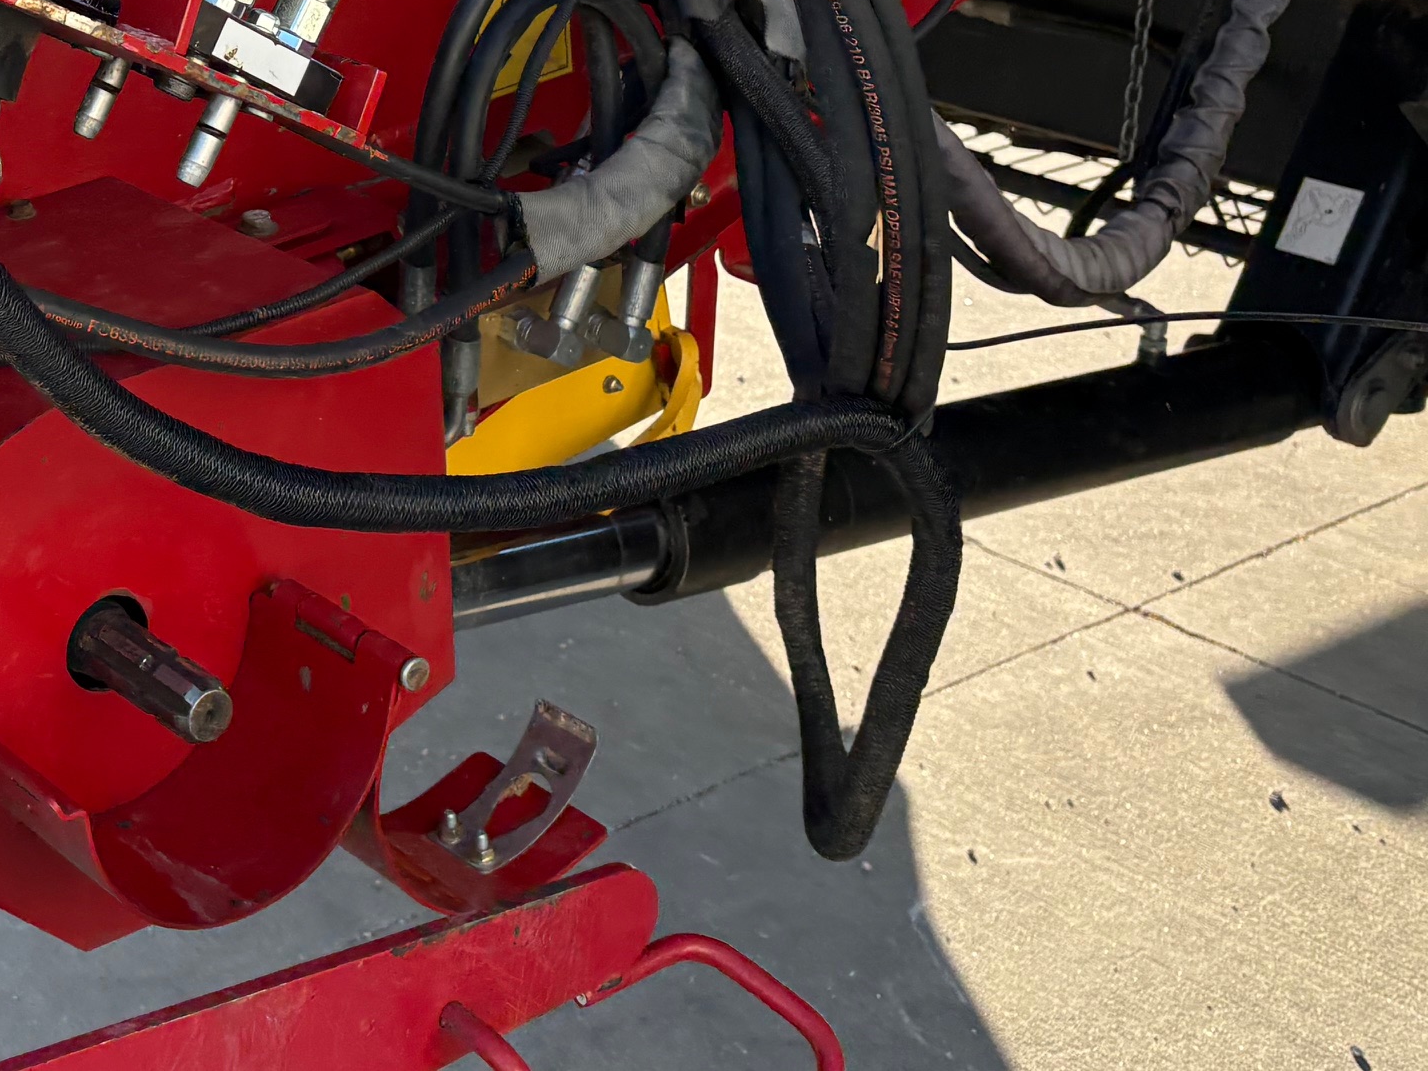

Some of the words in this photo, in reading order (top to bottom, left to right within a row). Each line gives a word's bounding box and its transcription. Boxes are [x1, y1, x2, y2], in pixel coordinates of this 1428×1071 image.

[844, 38, 865, 64] 210
[876, 146, 893, 169] PSI
[880, 174, 898, 206] MAX
